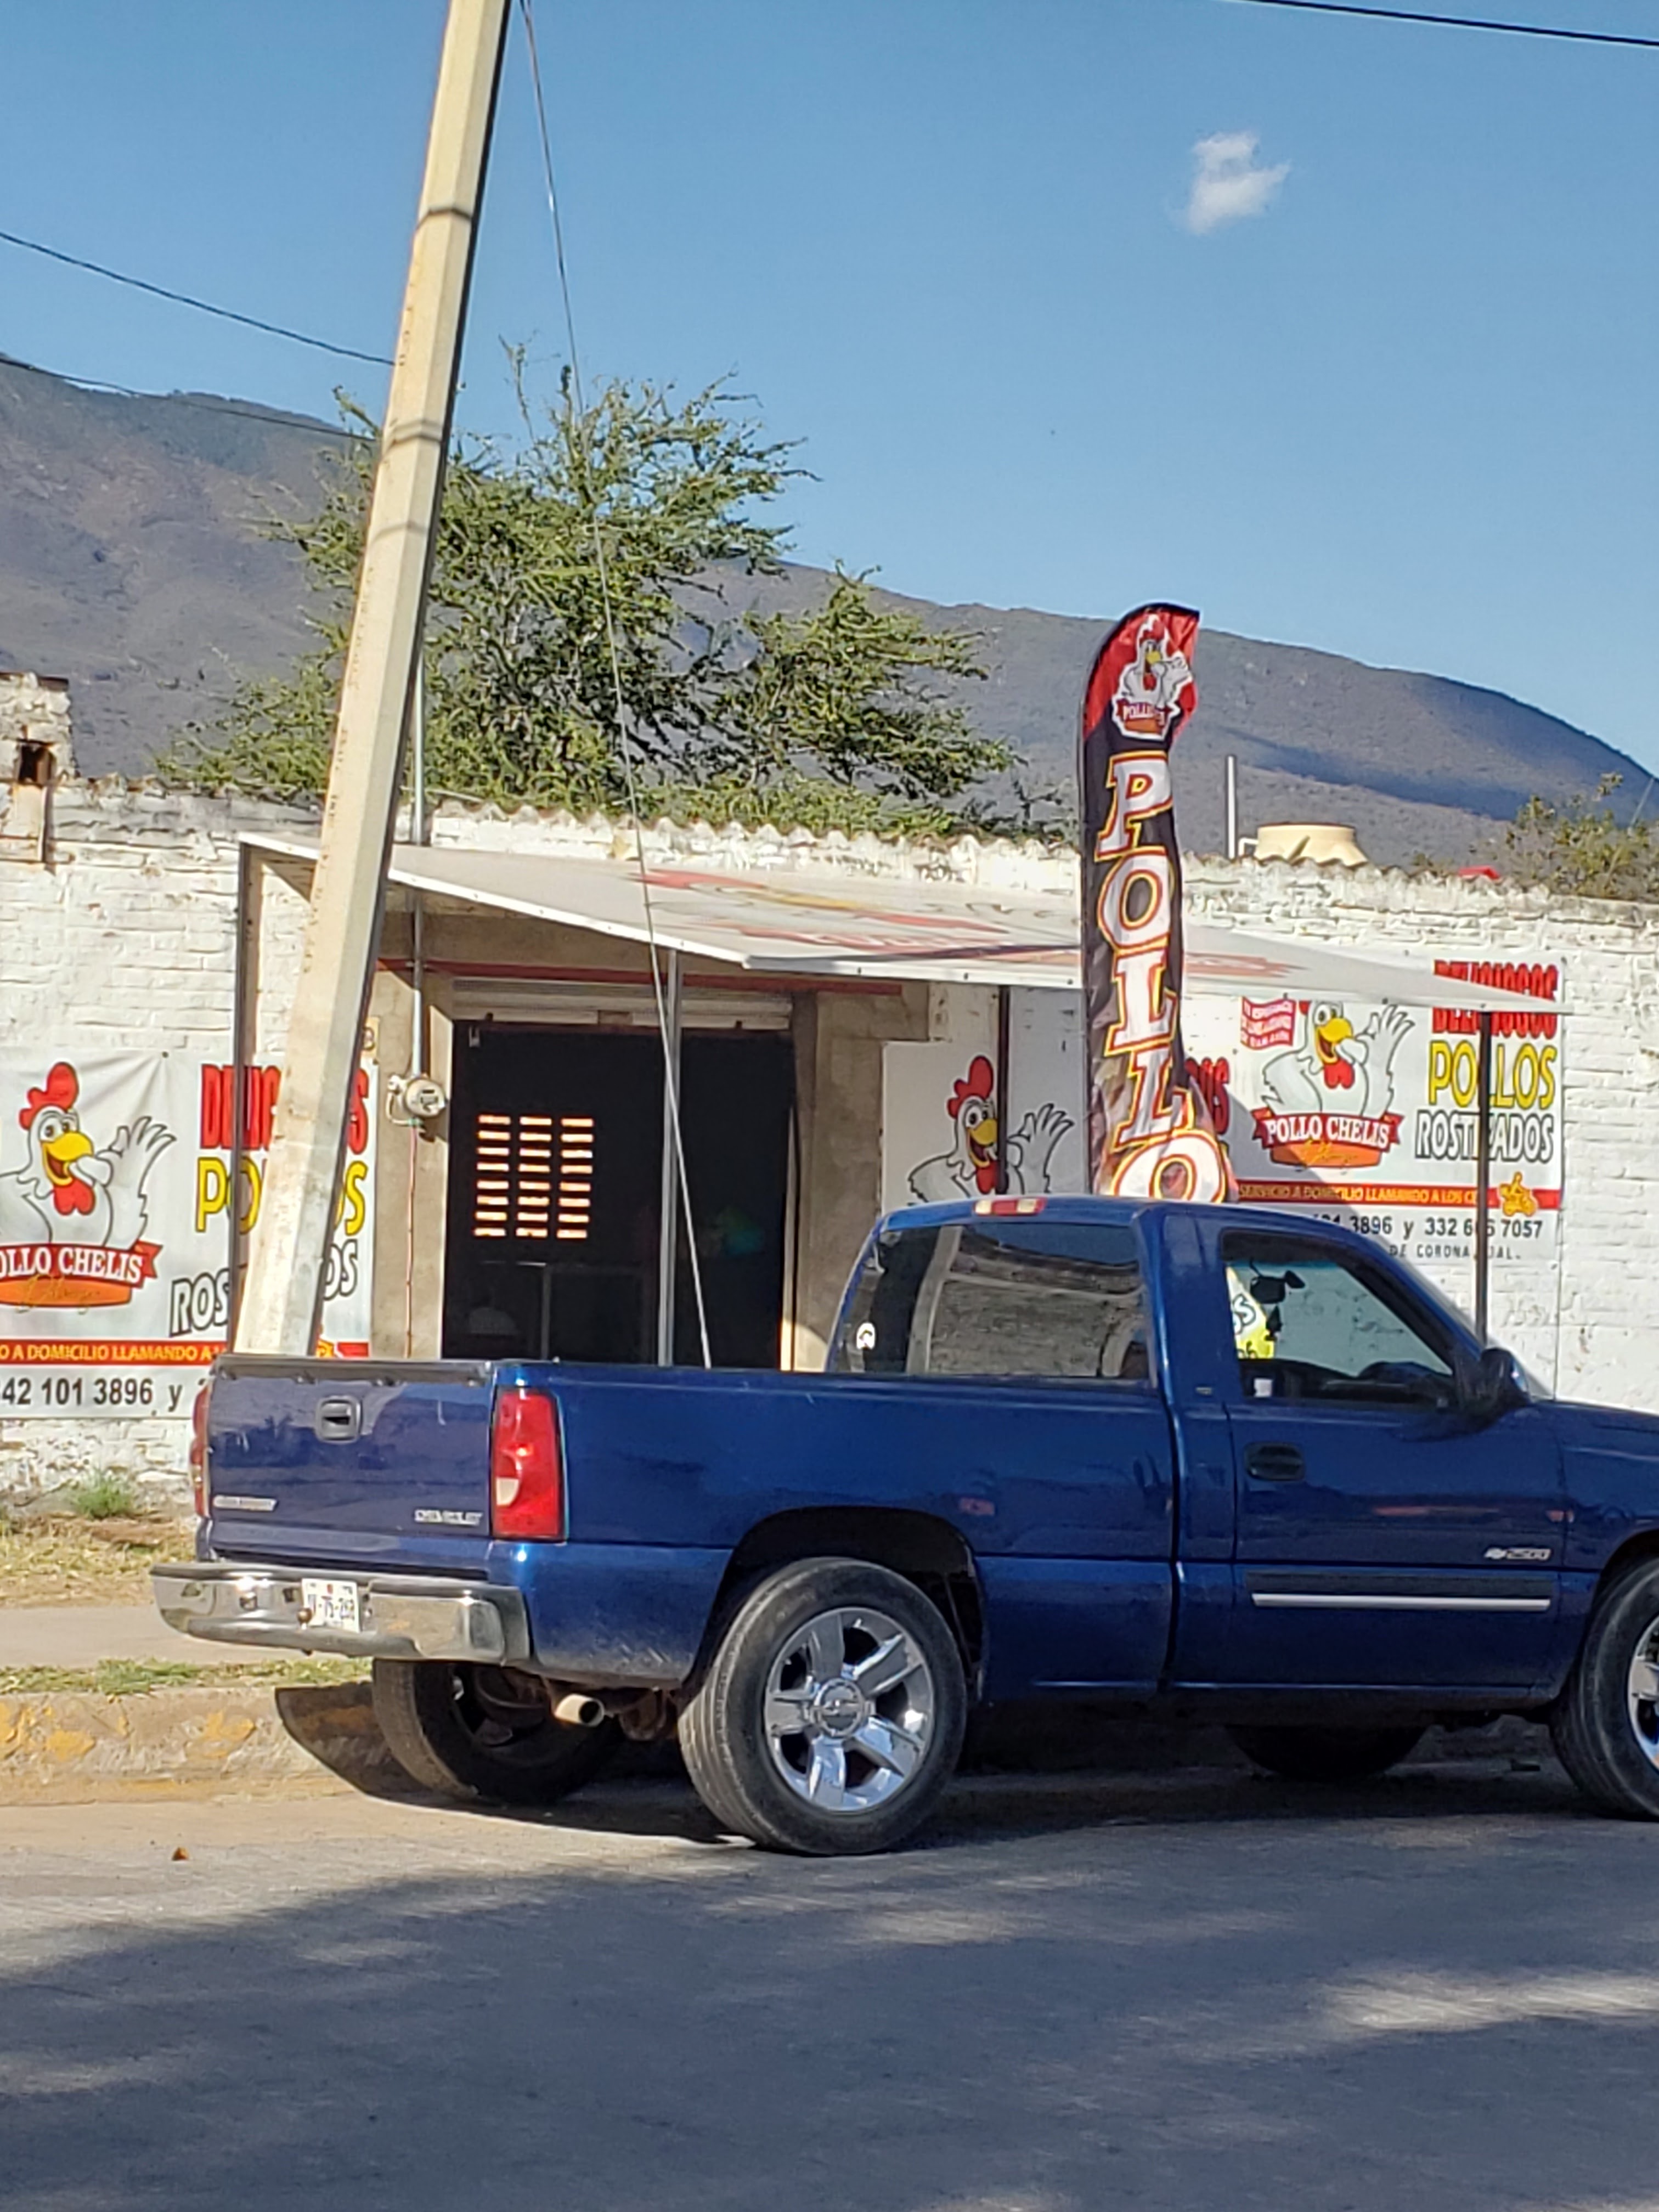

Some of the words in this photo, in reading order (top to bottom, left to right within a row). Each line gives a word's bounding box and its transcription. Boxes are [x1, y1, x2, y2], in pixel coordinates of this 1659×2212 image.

[1095, 751, 1228, 1202] POLLO
[1428, 1040, 1558, 1110] POLOS
[1263, 1115, 1323, 1144] POLLO
[1326, 1116, 1390, 1149] CHELIS
[1431, 1189, 1440, 1203] A
[1403, 1220, 1414, 1240] y
[1425, 1217, 1457, 1237] 332
[1464, 1218, 1496, 1238] 66
[1500, 1220, 1543, 1239] 7057
[58, 1246, 144, 1284] CHELIS
[12, 1345, 24, 1359] A
[27, 1345, 110, 1361] DOMICILIO
[111, 1345, 198, 1361] LLAMANDO
[41, 1377, 83, 1406] 101
[93, 1378, 154, 1406] 3896
[168, 1384, 183, 1413] y
